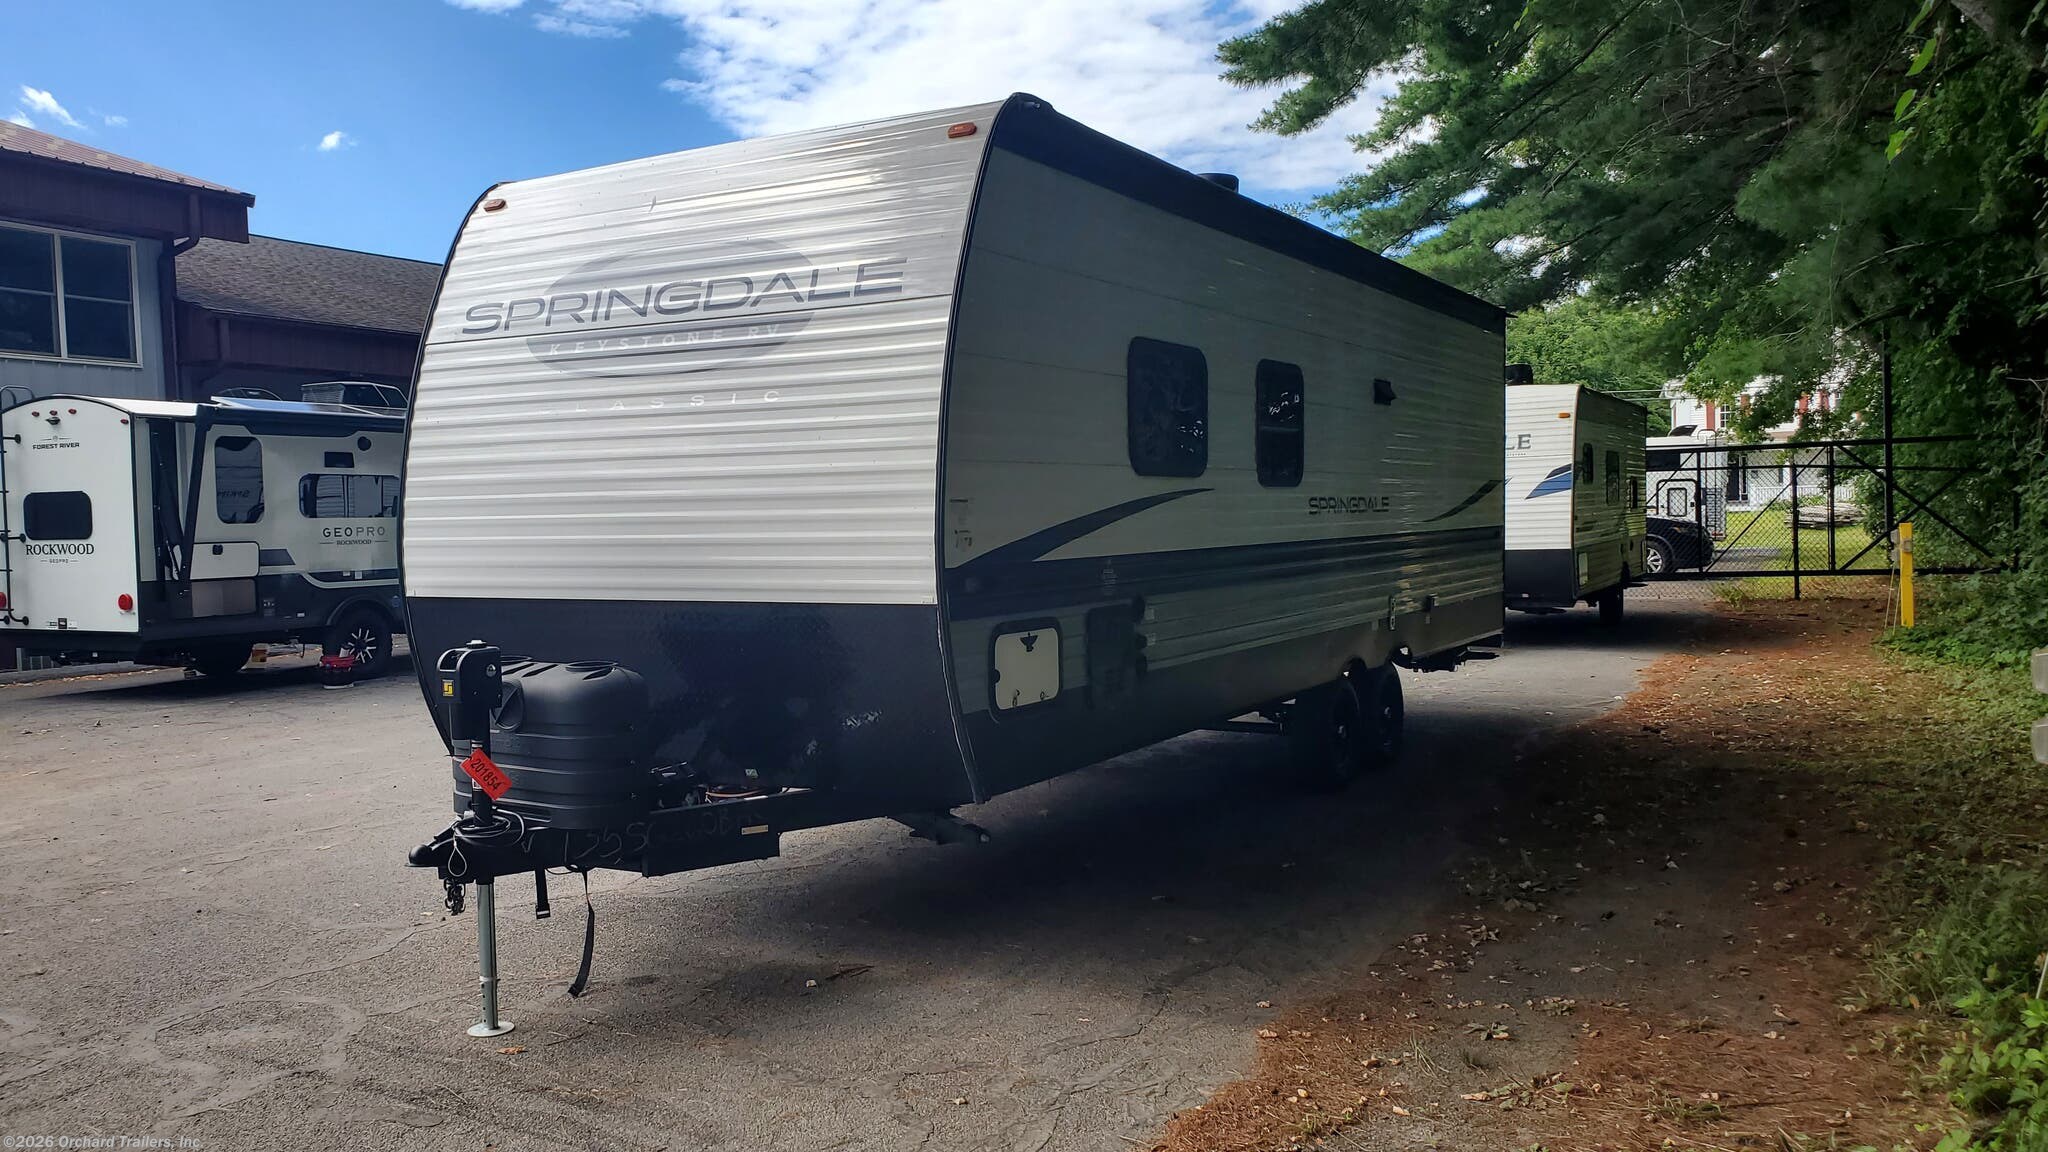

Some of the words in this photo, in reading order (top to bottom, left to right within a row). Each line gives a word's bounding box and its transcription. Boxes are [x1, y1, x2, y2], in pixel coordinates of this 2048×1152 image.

[462, 257, 908, 334] SPRINGDALE
[551, 328, 724, 355] KEYSTONE
[748, 323, 780, 339] RV
[543, 391, 779, 416] LASSIC
[1308, 496, 1390, 515] SPRINGDALE
[322, 526, 386, 538] GEOPRO
[25, 543, 95, 556] ROCKWOOD
[470, 759, 503, 791] 201854
